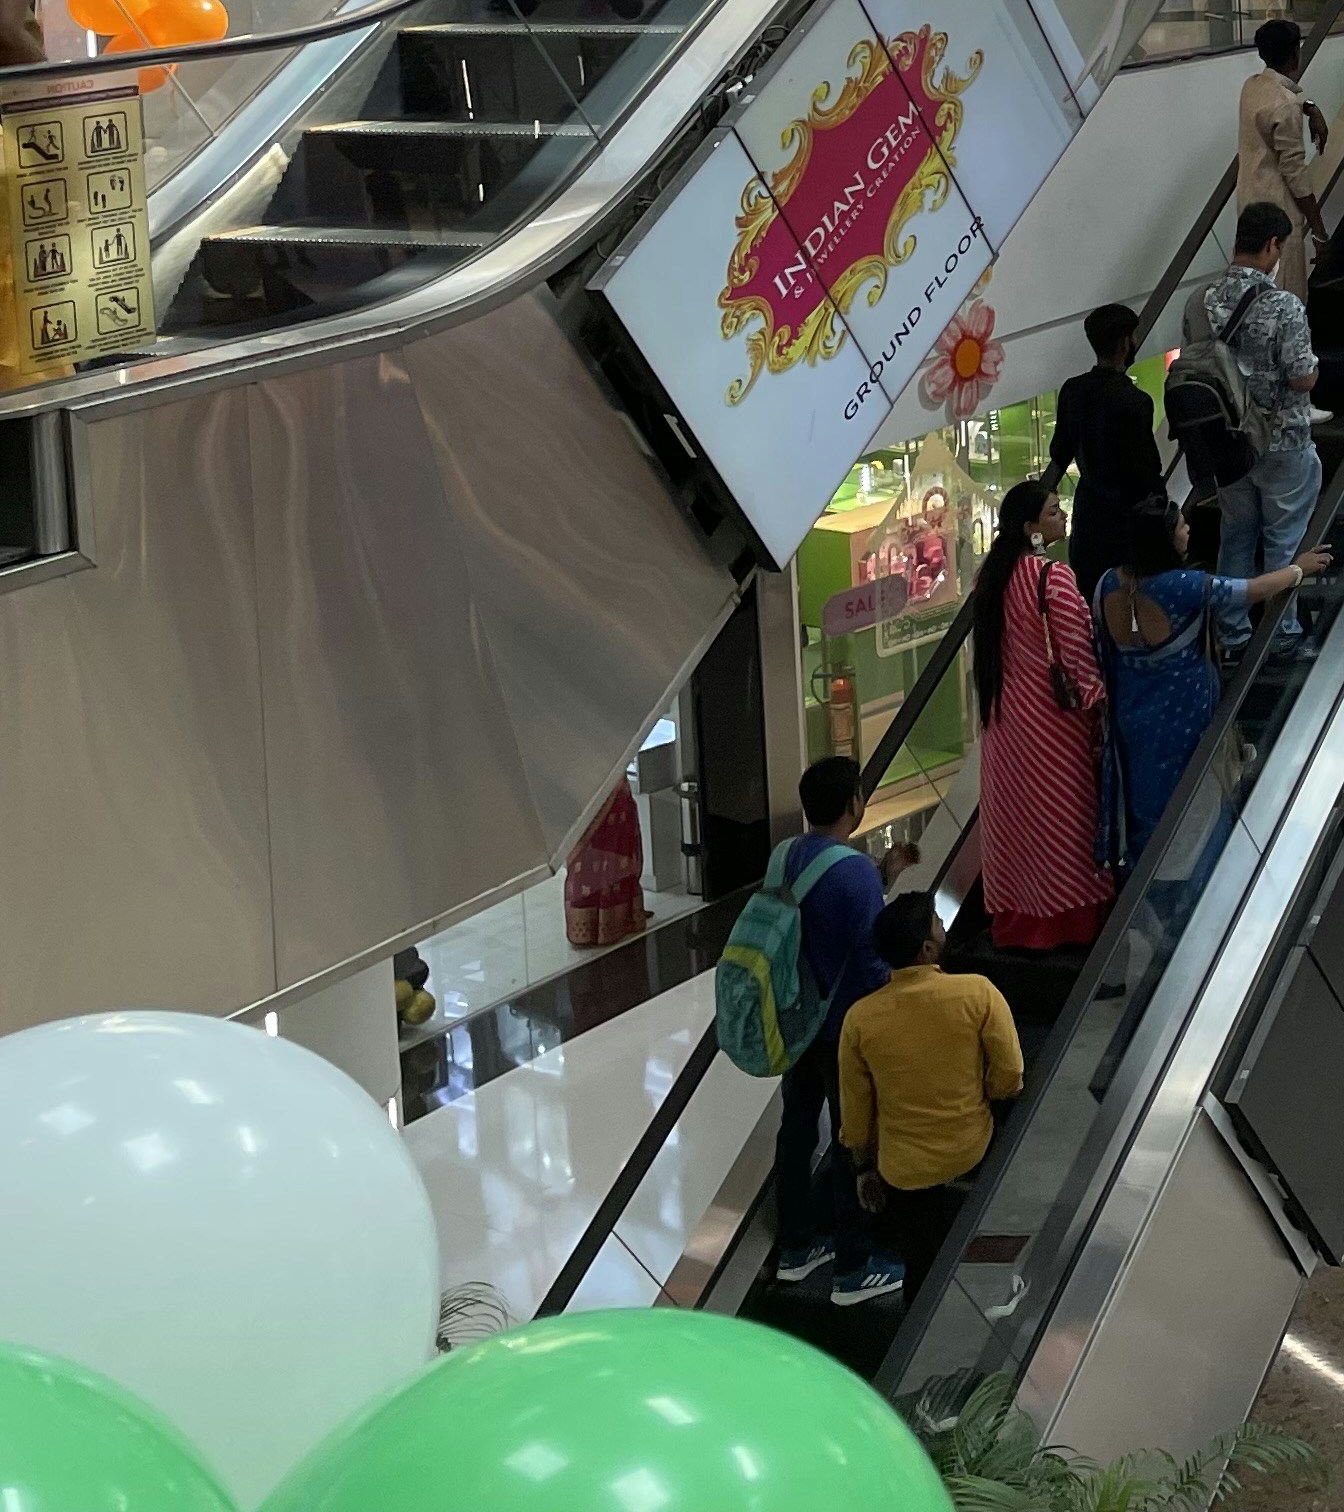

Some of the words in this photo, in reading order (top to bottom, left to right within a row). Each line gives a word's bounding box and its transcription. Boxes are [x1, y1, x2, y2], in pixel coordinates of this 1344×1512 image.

[773, 171, 867, 299] INDIAN
[867, 100, 923, 171] GEM
[866, 128, 921, 198] CREATION
[844, 306, 922, 421] GROUND
[924, 216, 985, 303] FLOOR
